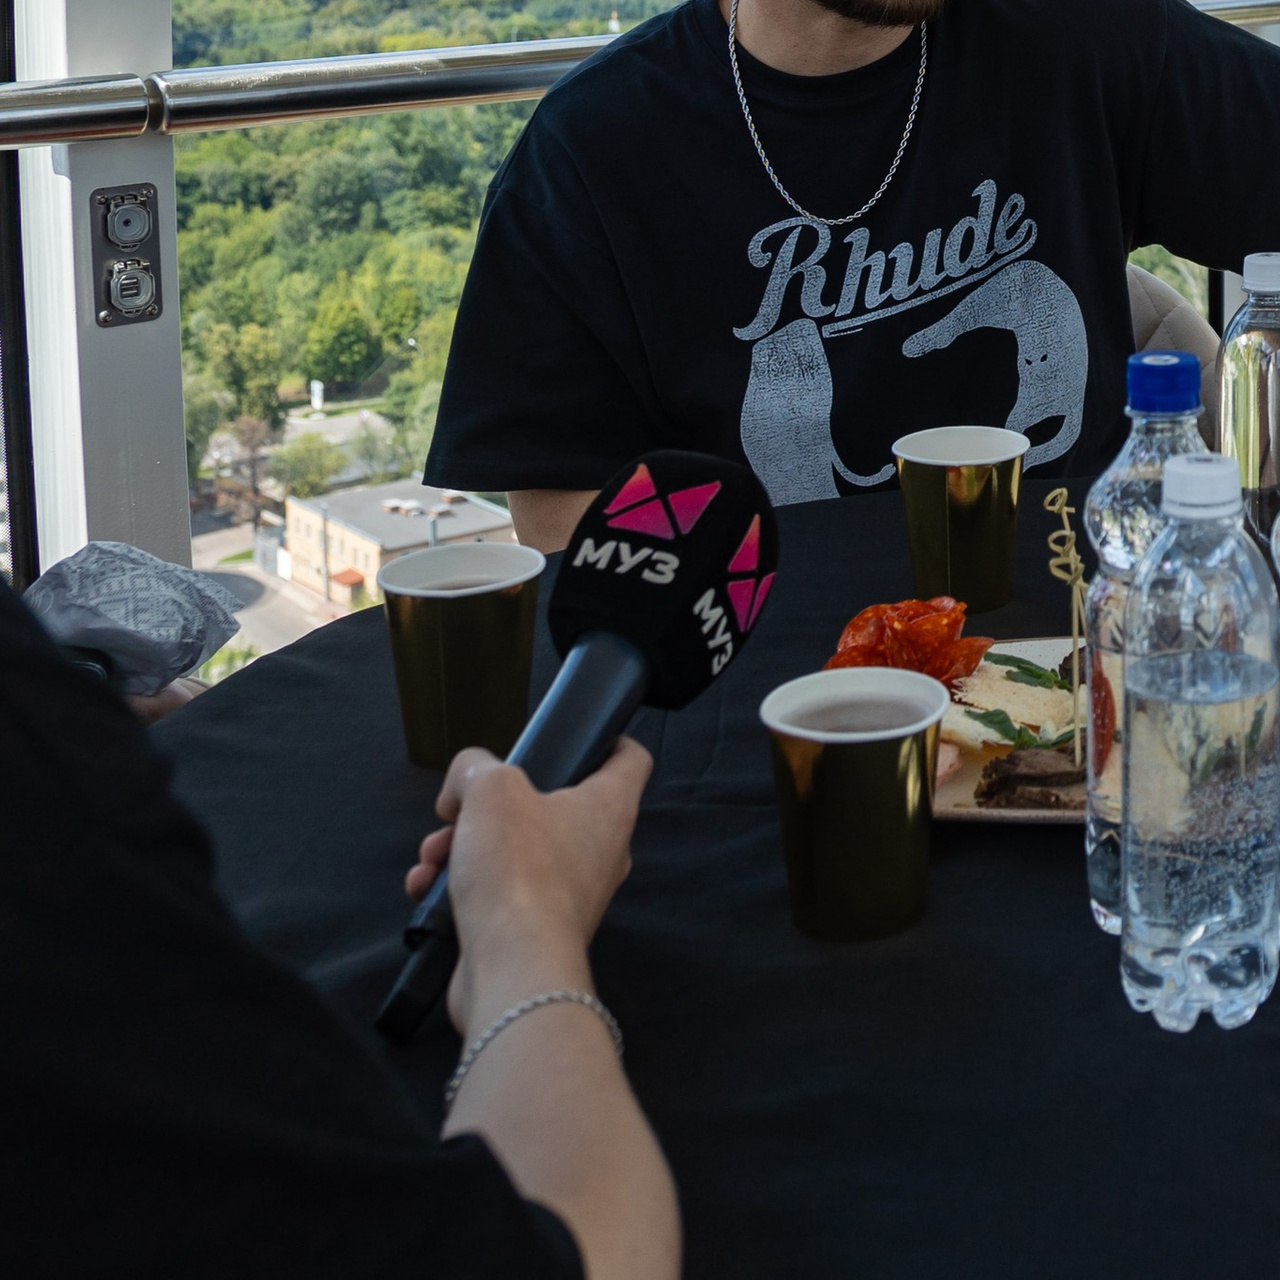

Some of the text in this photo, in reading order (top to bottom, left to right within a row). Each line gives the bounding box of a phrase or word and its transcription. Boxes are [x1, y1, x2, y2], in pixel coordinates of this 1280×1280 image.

[733, 179, 1037, 341] Rhude
[572, 537, 680, 585] МУЗ
[692, 588, 734, 676] МУЗ
